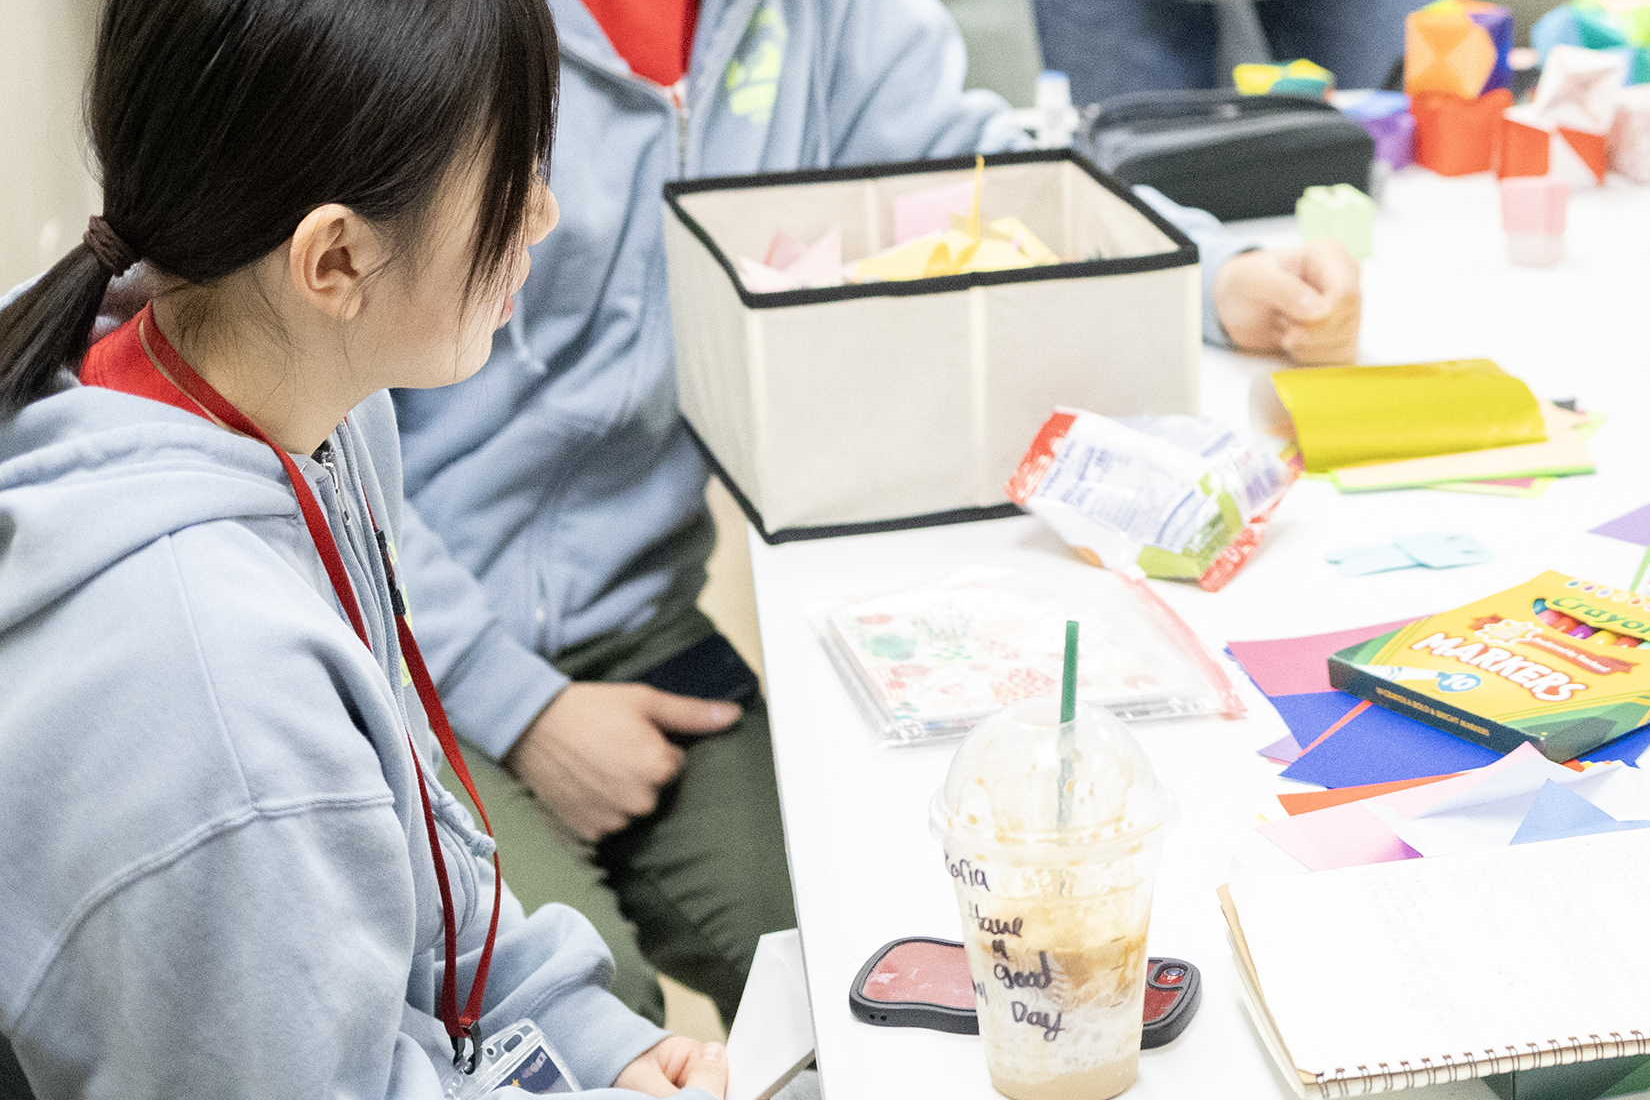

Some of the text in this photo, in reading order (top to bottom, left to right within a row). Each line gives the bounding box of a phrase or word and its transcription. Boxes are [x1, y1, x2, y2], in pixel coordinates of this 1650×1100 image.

[1411, 632, 1588, 701] MARKERS
[1441, 673, 1477, 691] 10
[993, 950, 1053, 990] good
[1011, 1001, 1066, 1042] Day
